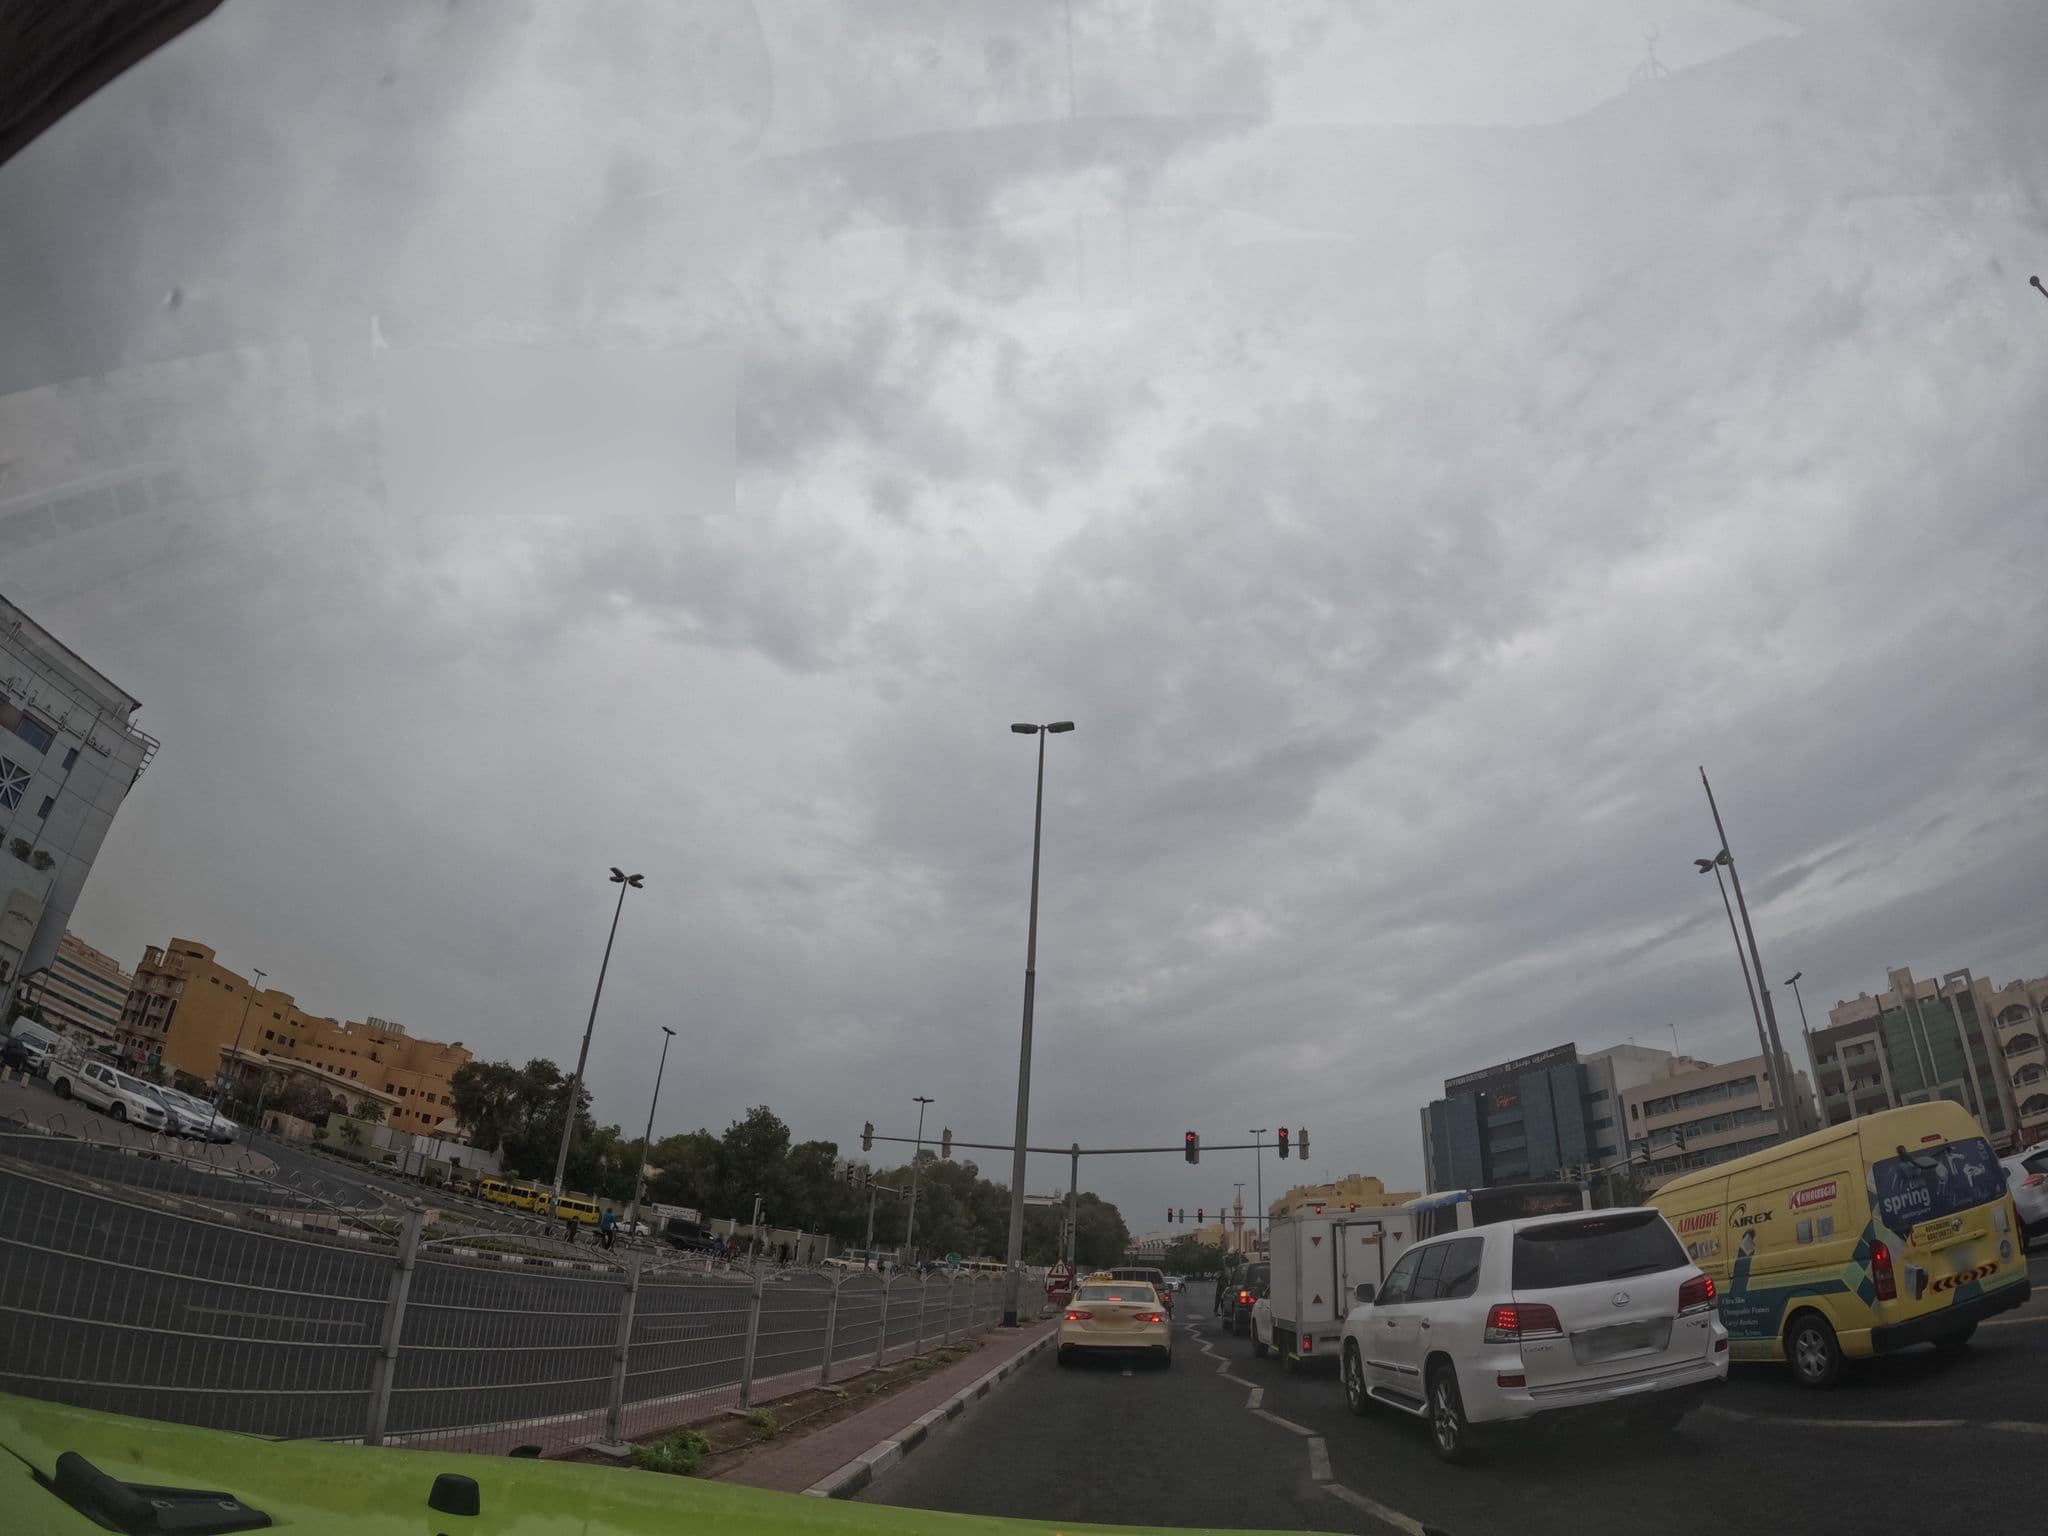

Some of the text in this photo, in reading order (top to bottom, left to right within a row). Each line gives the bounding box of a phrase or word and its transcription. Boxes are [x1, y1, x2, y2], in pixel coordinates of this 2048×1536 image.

[1884, 1188, 1931, 1214] spring
[1677, 1210, 1721, 1234] ADMORE
[1731, 1210, 1773, 1229] AIREX
